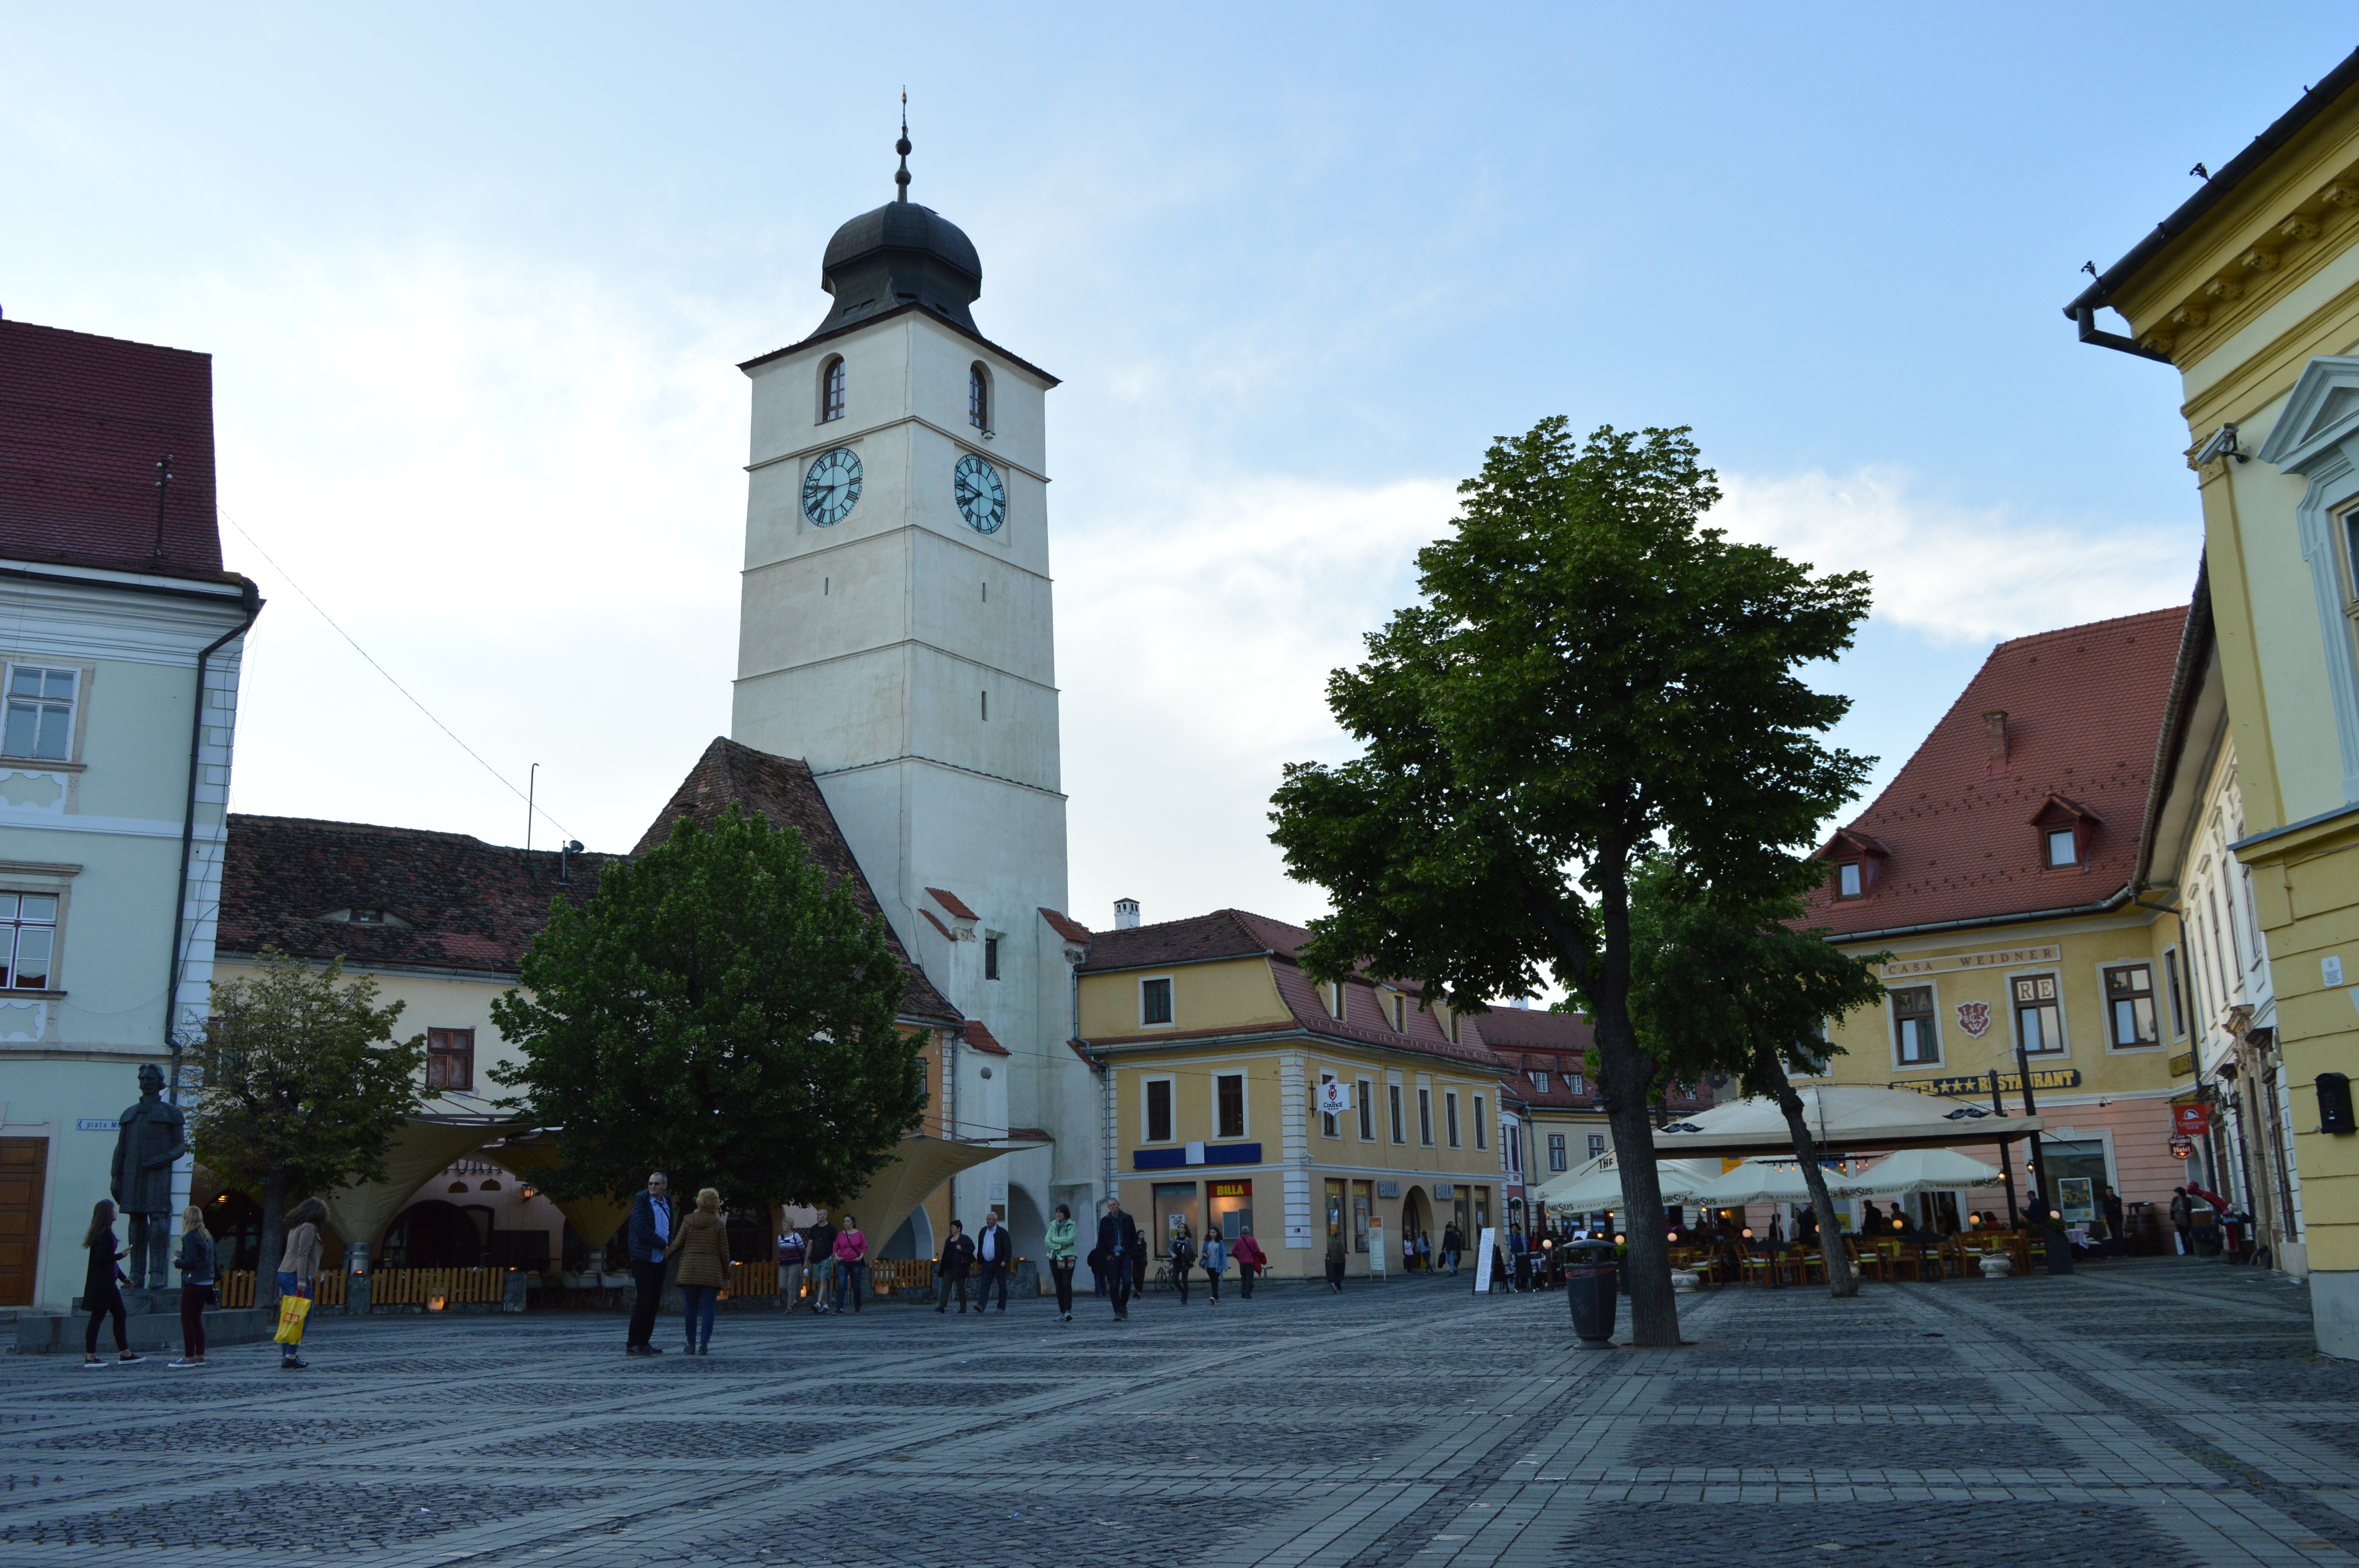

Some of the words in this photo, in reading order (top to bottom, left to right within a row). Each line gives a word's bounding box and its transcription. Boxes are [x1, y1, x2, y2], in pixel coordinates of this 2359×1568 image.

[1888, 962, 1933, 975] CASA
[1959, 948, 2052, 967] WEIDNER
[1978, 1070, 2074, 1092] RSTARANT
[1217, 1185, 1244, 1196] BILLA
[1326, 1183, 1339, 1194] BILLA
[1353, 1185, 1367, 1195] BILLA
[1379, 1180, 1402, 1197] BILLA
[1845, 1187, 1874, 1196] URSUS
[1548, 1203, 1574, 1212] URSUS
[1690, 1197, 1717, 1207] URSUS
